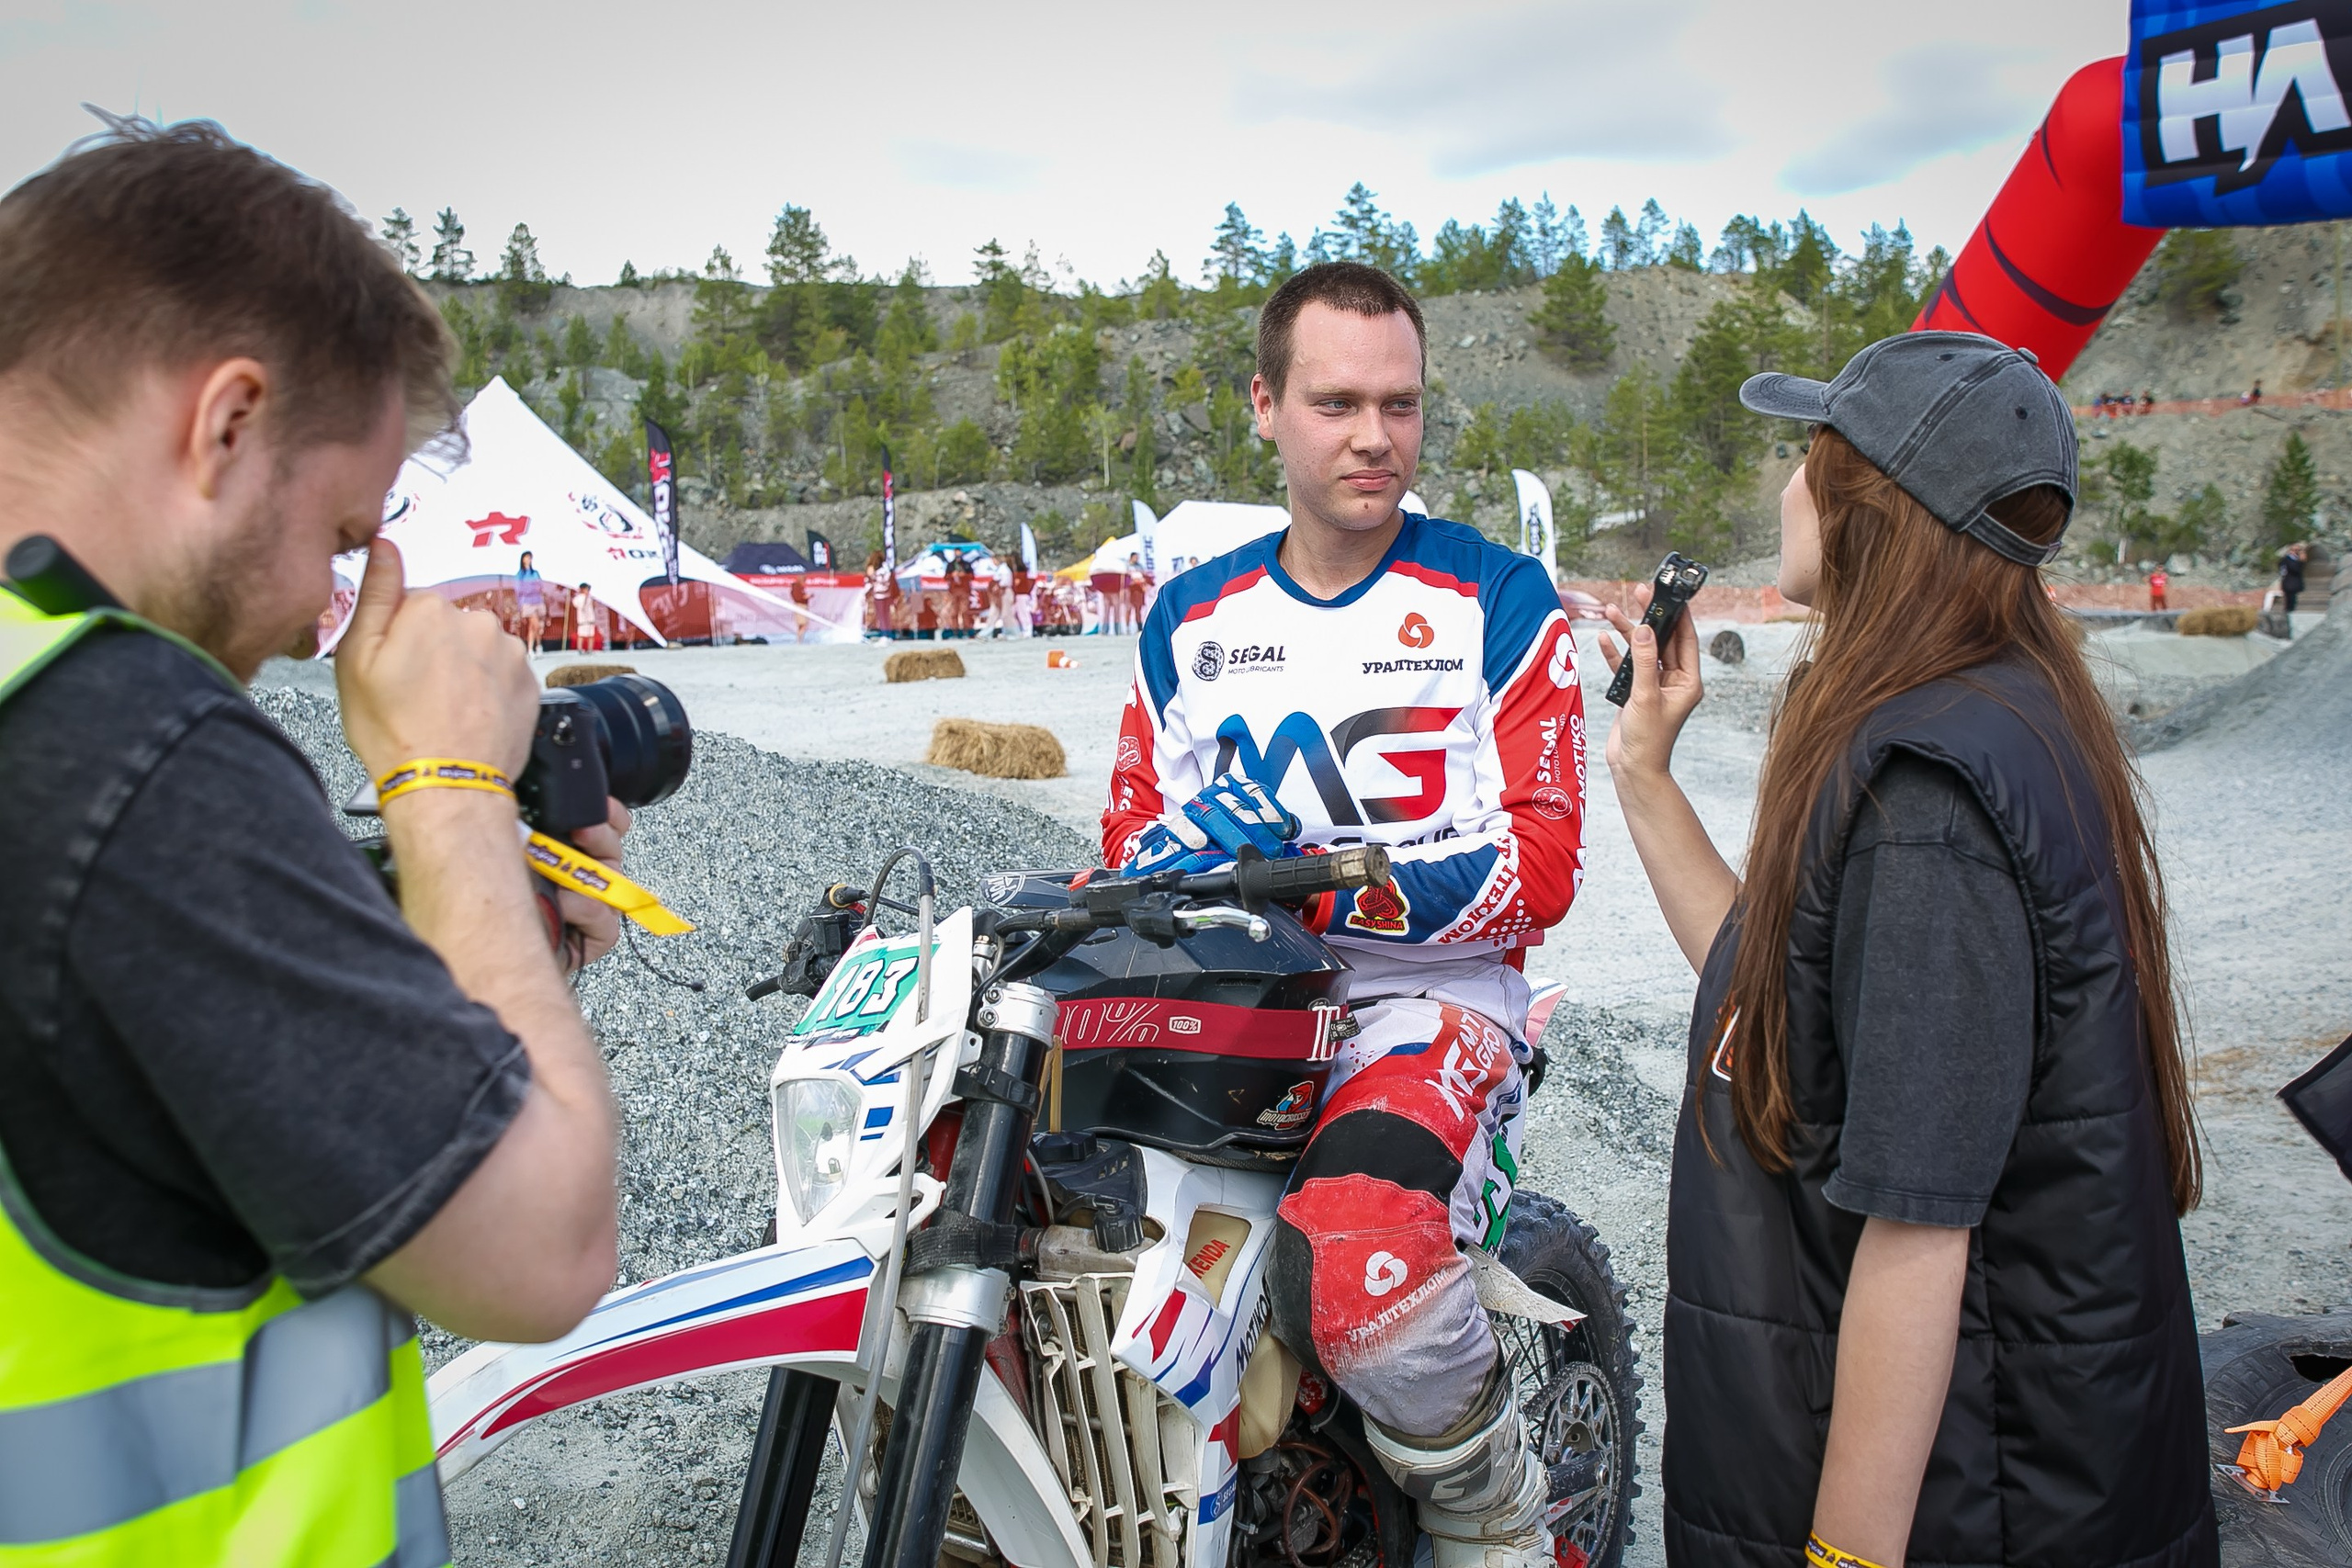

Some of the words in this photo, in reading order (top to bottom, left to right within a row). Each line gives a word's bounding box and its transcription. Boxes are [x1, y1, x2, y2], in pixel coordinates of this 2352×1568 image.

[1228, 646, 1286, 665] SEGAL
[1363, 659, 1464, 674] УРАЛТЕХЛОМ
[1569, 714, 1587, 800] MOTIKO
[1350, 916, 1377, 930] EASY
[1377, 920, 1405, 931] SHINA
[817, 955, 919, 1024] 183
[1172, 1020, 1198, 1032] 100%
